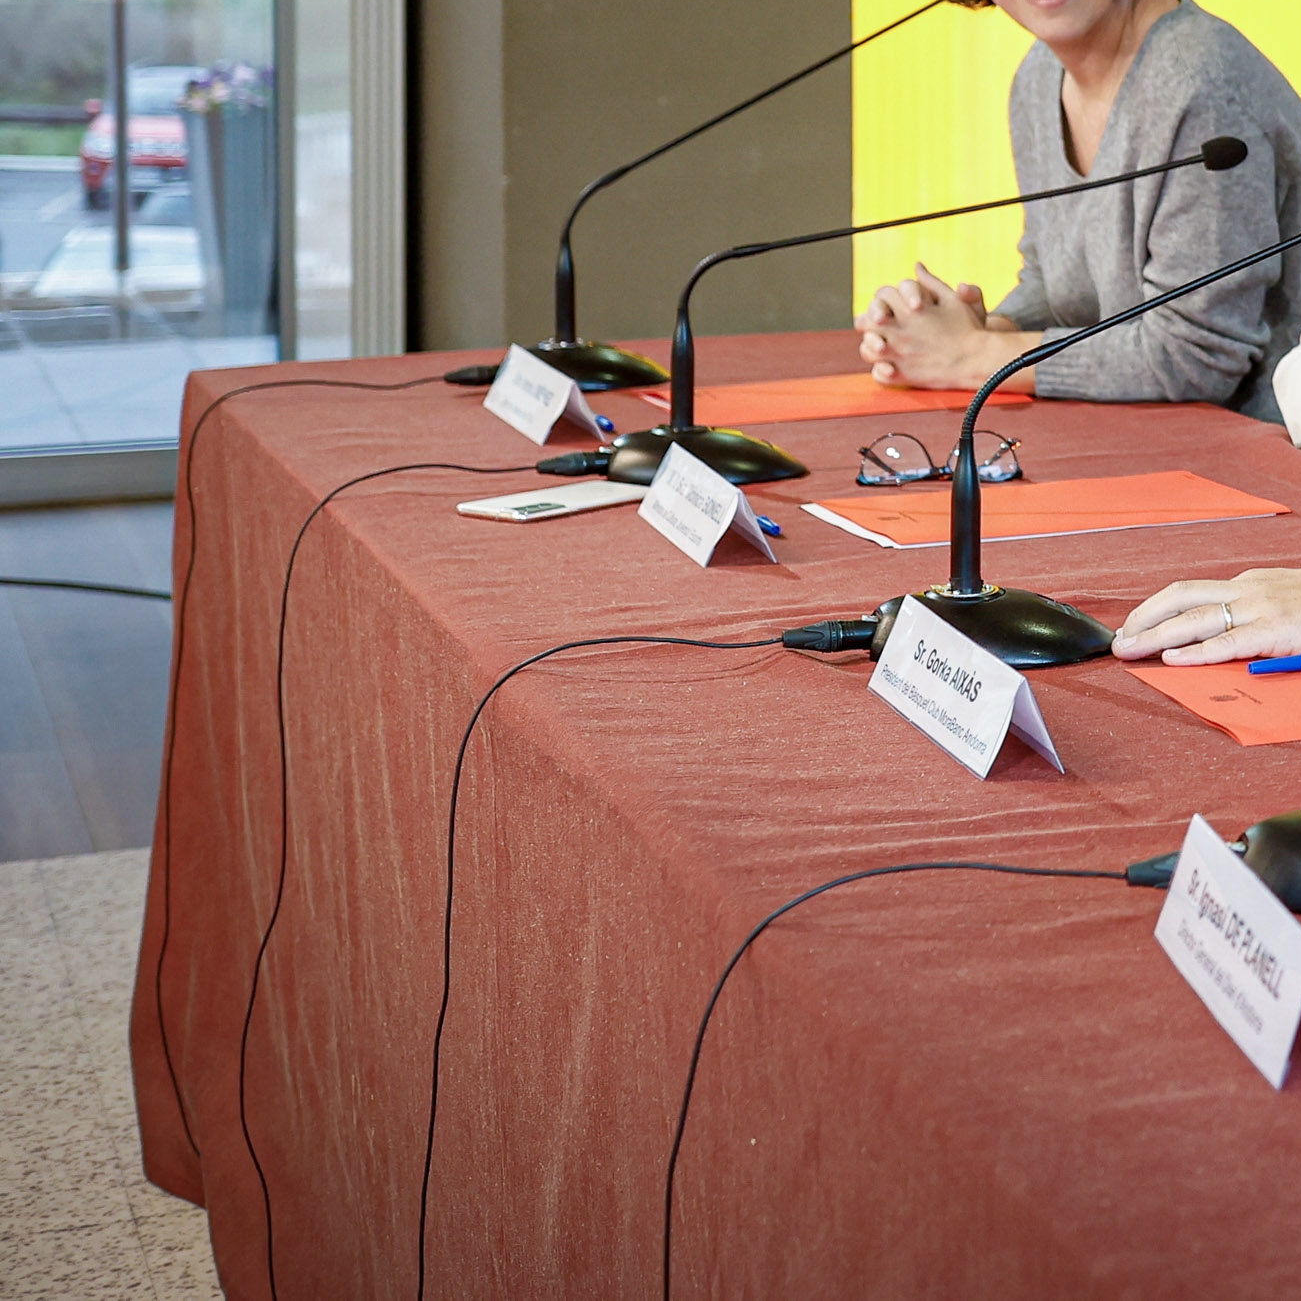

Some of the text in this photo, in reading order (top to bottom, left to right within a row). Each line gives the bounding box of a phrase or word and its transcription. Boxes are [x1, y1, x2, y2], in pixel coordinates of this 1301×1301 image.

[913, 639, 982, 703] Sr. Gorka AIXÀS
